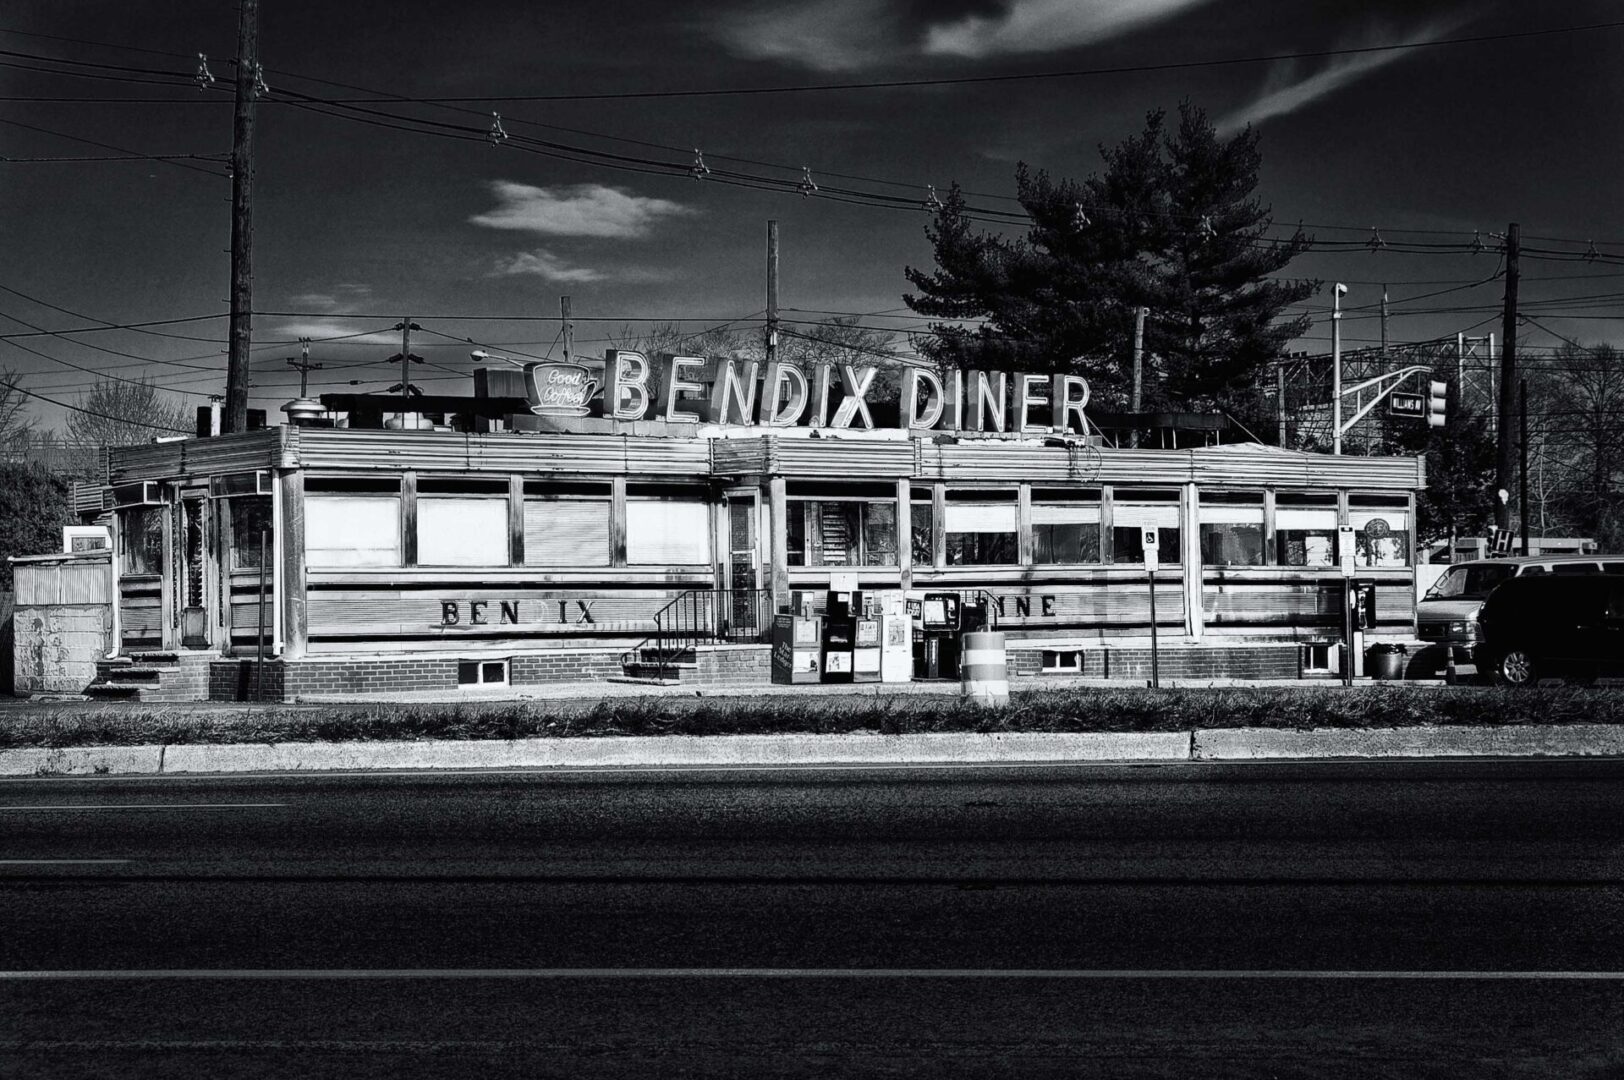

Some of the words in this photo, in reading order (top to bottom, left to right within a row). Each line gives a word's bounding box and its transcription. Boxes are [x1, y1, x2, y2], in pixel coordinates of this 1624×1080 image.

[549, 369, 581, 385] Good
[543, 386, 584, 406] Coffee
[604, 350, 877, 429] BENDIX
[905, 366, 1089, 435] DINER
[1496, 531, 1510, 551] H
